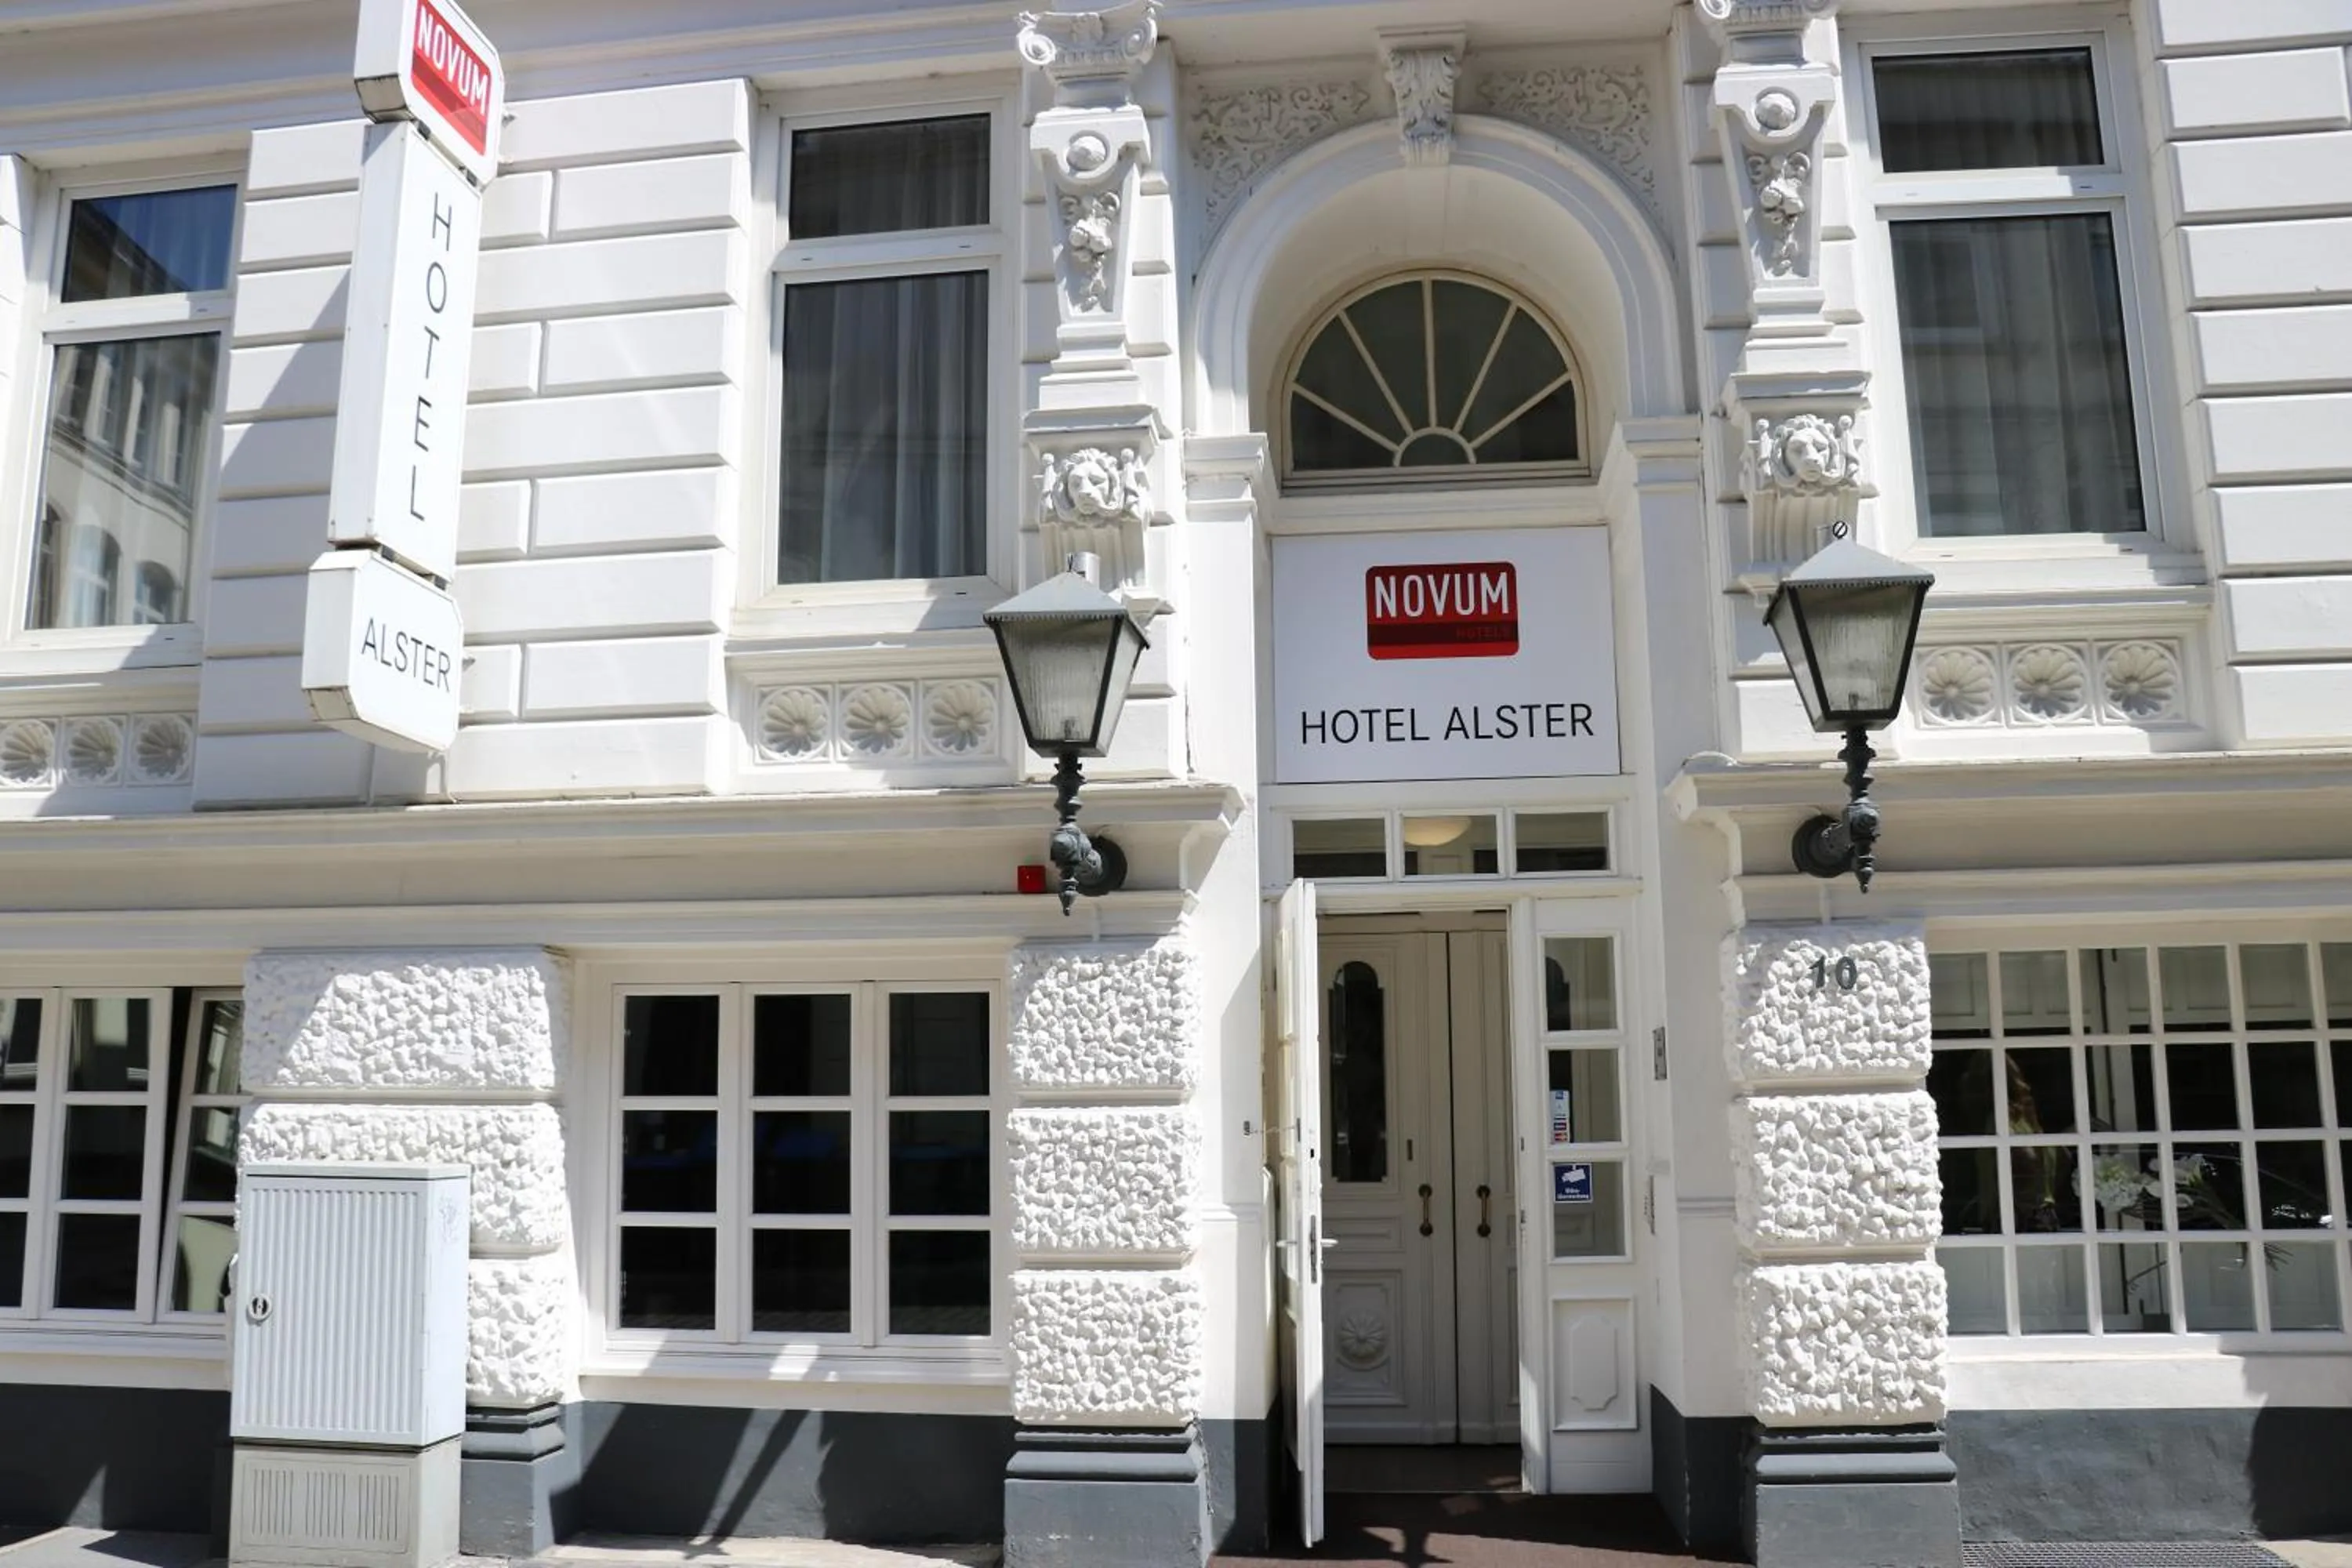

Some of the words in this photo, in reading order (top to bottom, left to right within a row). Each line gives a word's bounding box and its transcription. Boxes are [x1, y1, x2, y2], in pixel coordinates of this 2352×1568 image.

[417, 4, 489, 116] NOVUM
[410, 192, 452, 521] HOTEL
[1374, 572, 1510, 619] NOVUM
[361, 617, 451, 693] ALSTER
[1301, 709, 1430, 744] HOTEL
[1443, 703, 1595, 741] ALSTER
[1809, 955, 1857, 990] 10
